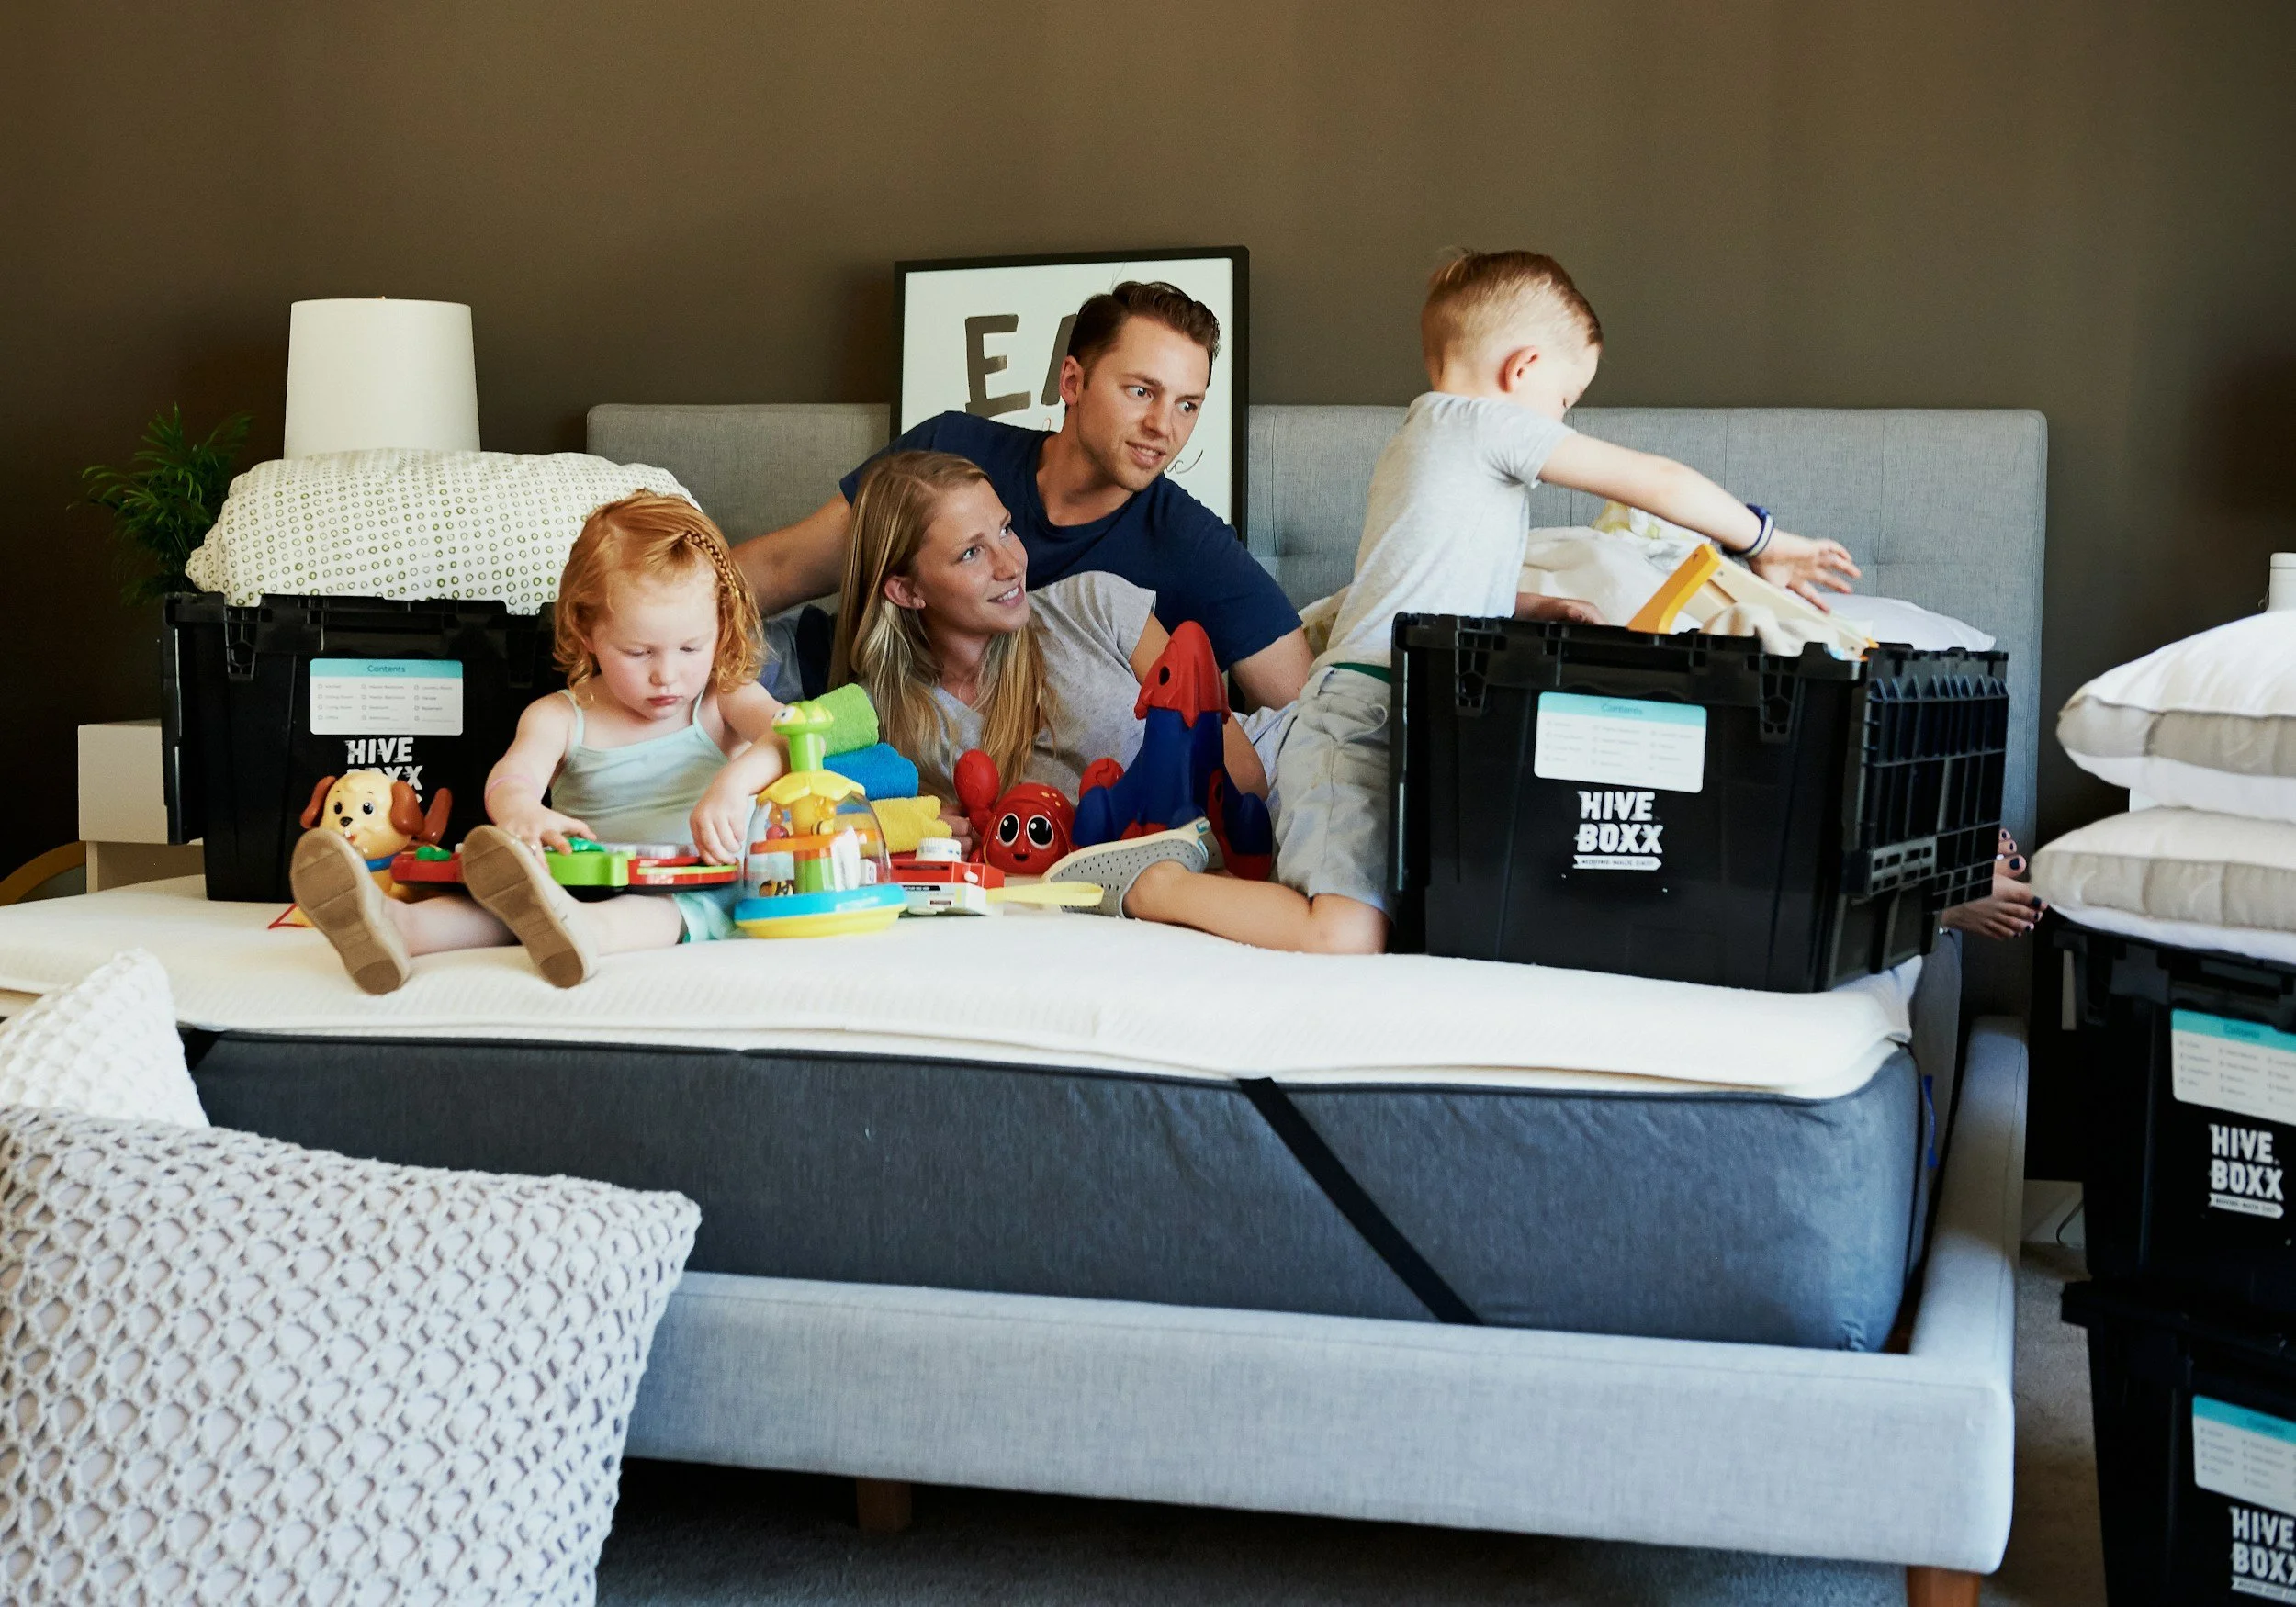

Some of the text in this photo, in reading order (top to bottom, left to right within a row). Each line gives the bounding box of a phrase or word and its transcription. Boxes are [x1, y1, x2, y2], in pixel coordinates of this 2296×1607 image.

[367, 664, 406, 673] Contents
[344, 736, 414, 765] HIVE
[1577, 791, 1656, 822] HIVE
[1573, 823, 1664, 855] BOXX
[2208, 1123, 2275, 1164] HIVE
[2208, 1158, 2285, 1202] BOXX
[2229, 1505, 2295, 1551] HIVE
